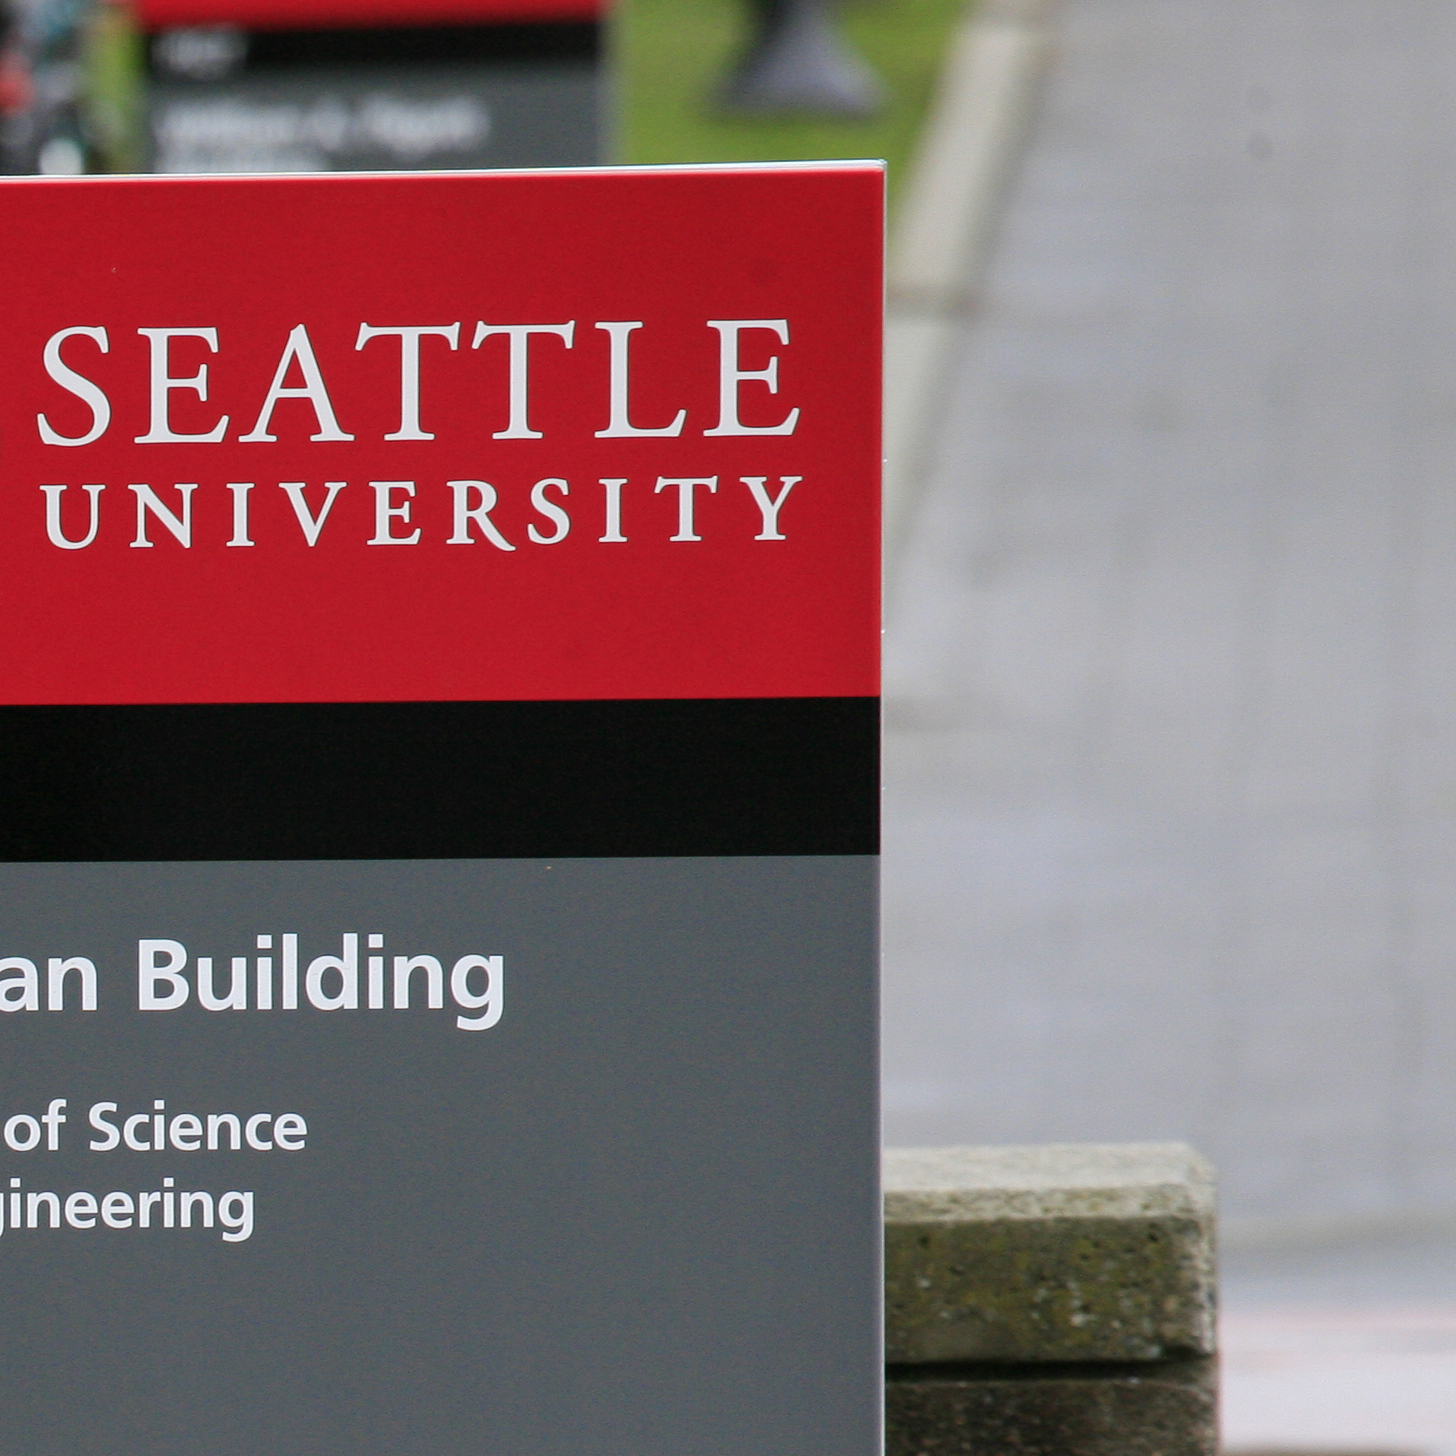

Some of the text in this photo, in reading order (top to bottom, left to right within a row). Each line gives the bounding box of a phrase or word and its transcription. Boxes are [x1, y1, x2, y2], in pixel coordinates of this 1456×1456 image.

[36, 318, 801, 448] SEATTLE
[38, 474, 804, 553] UNIVERSITY
[137, 931, 505, 1032] Building
[2, 1098, 68, 1153] of
[87, 1099, 309, 1153] Science
